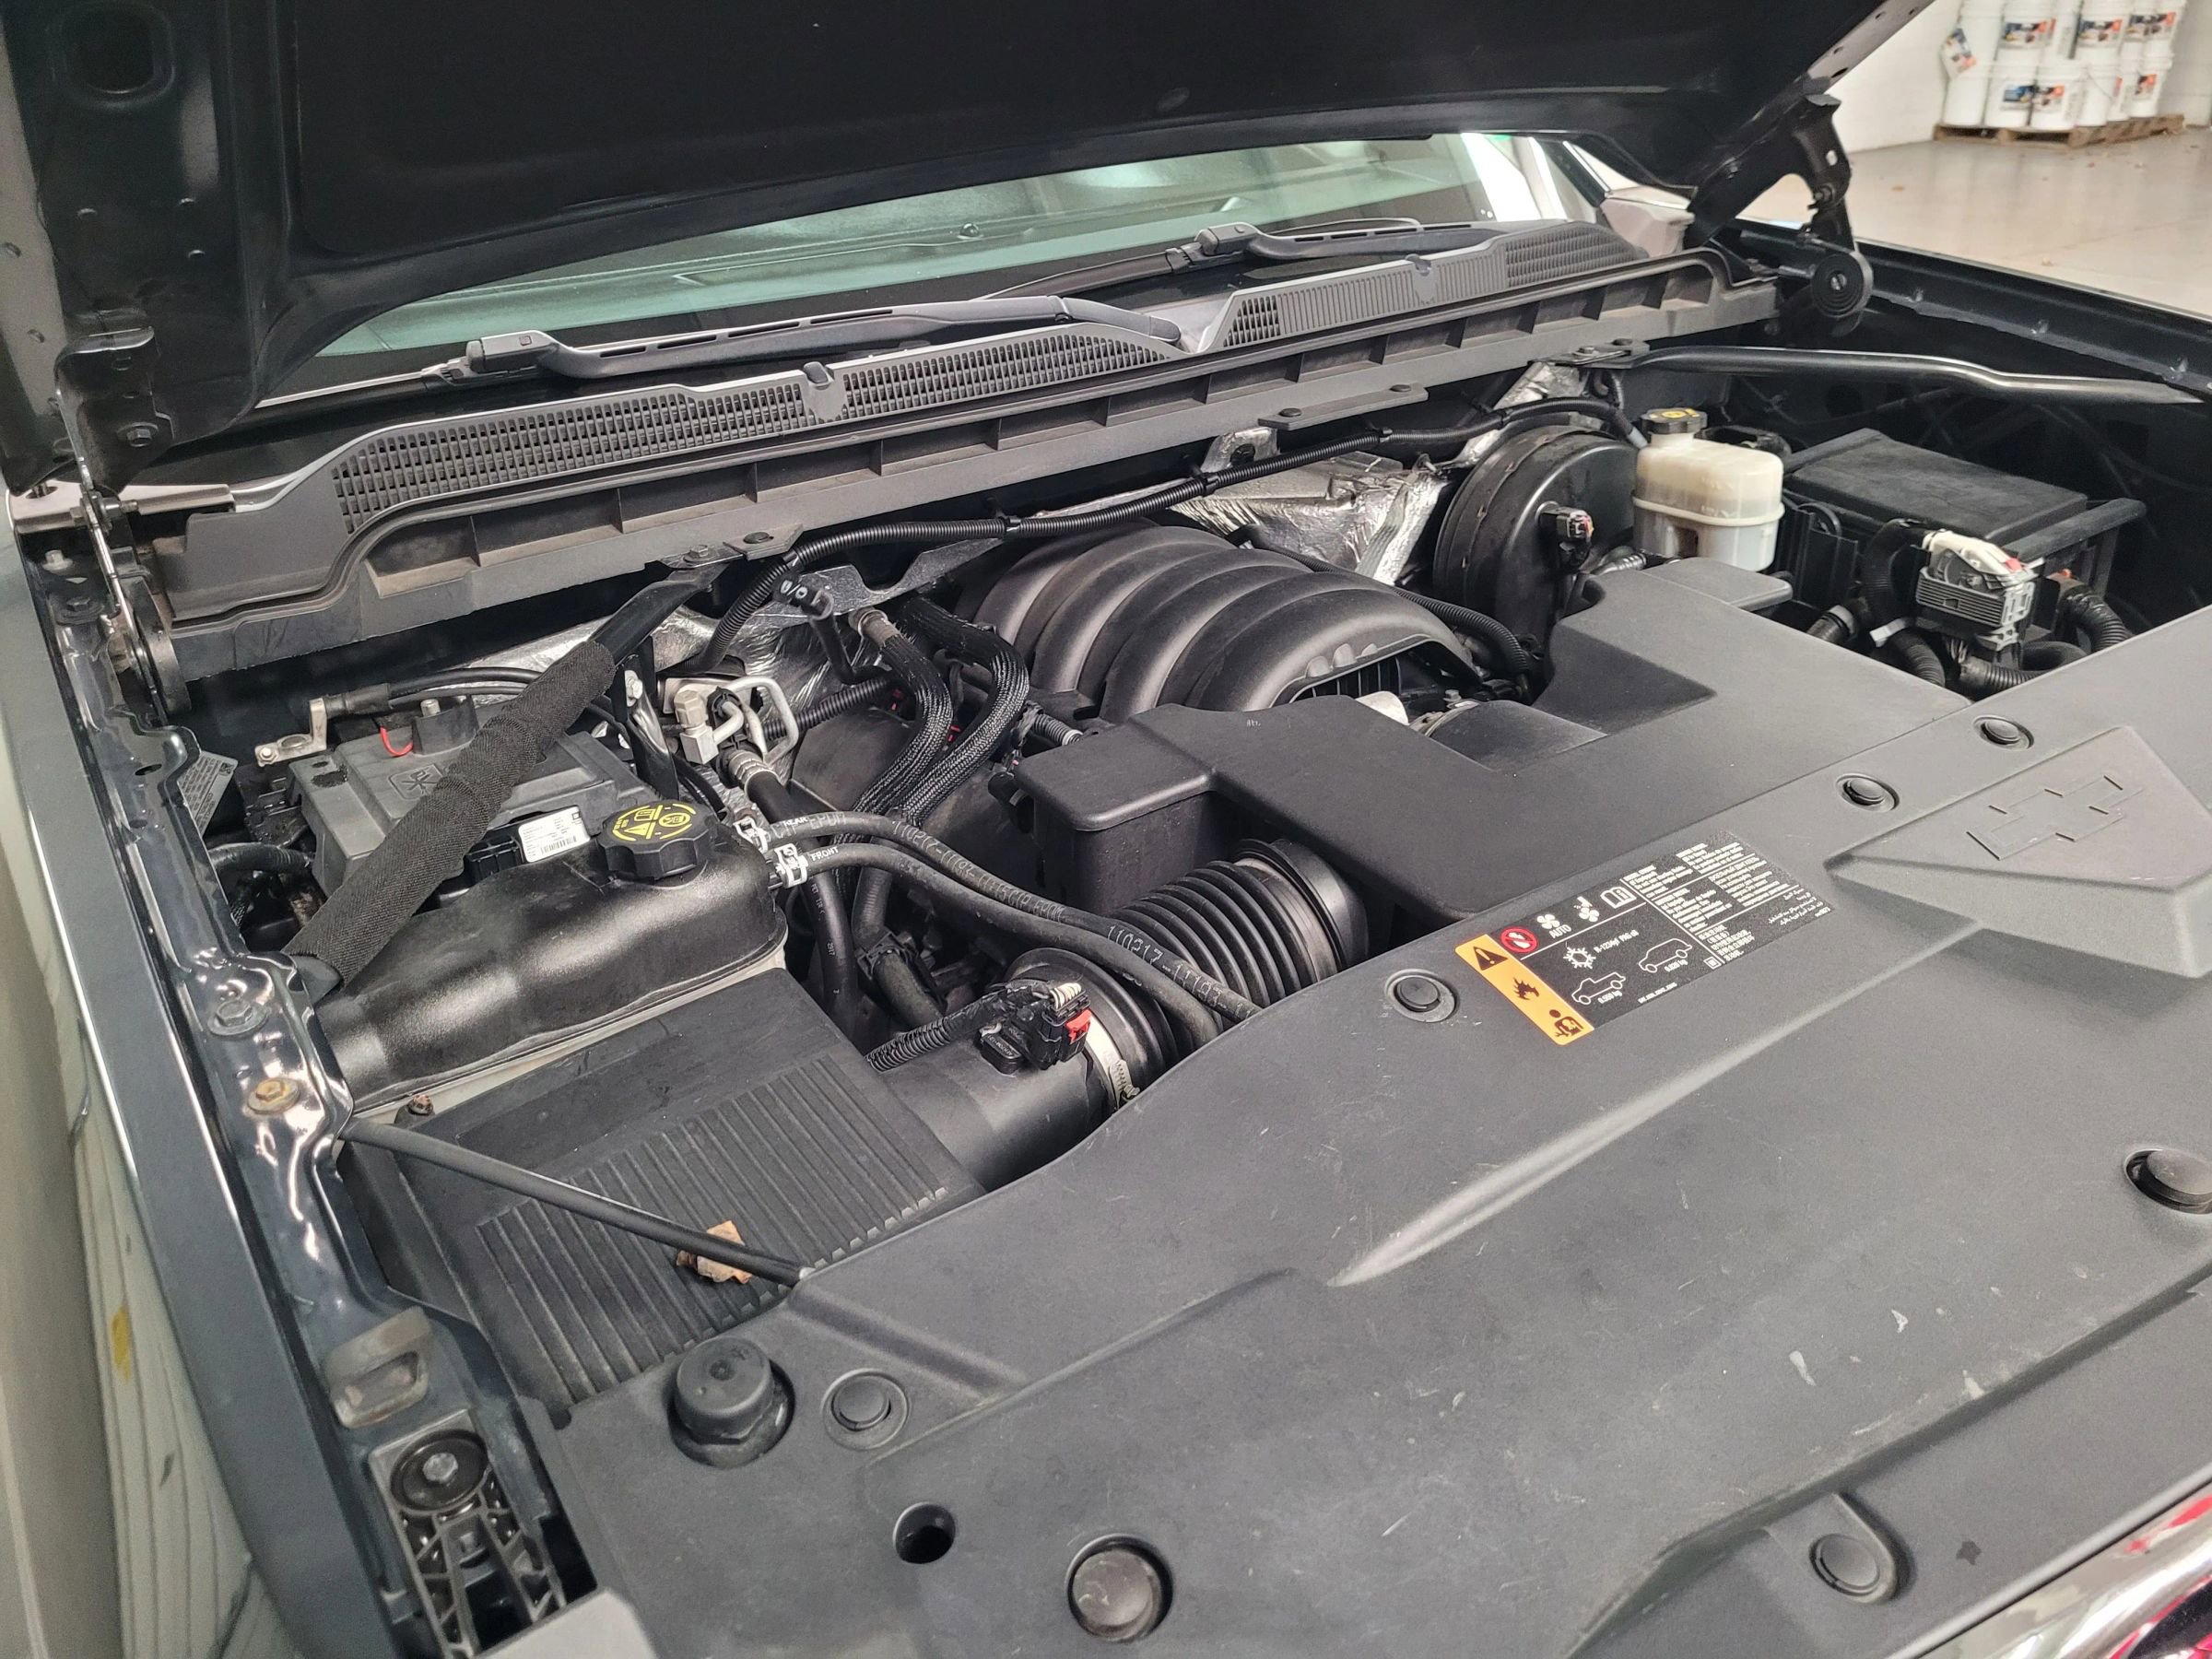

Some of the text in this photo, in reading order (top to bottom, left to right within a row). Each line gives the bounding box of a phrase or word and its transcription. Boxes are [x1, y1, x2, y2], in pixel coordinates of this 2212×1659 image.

[782, 817, 808, 827] REAR
[809, 846, 840, 862] FRONT
[1549, 924, 1571, 938] AUTO
